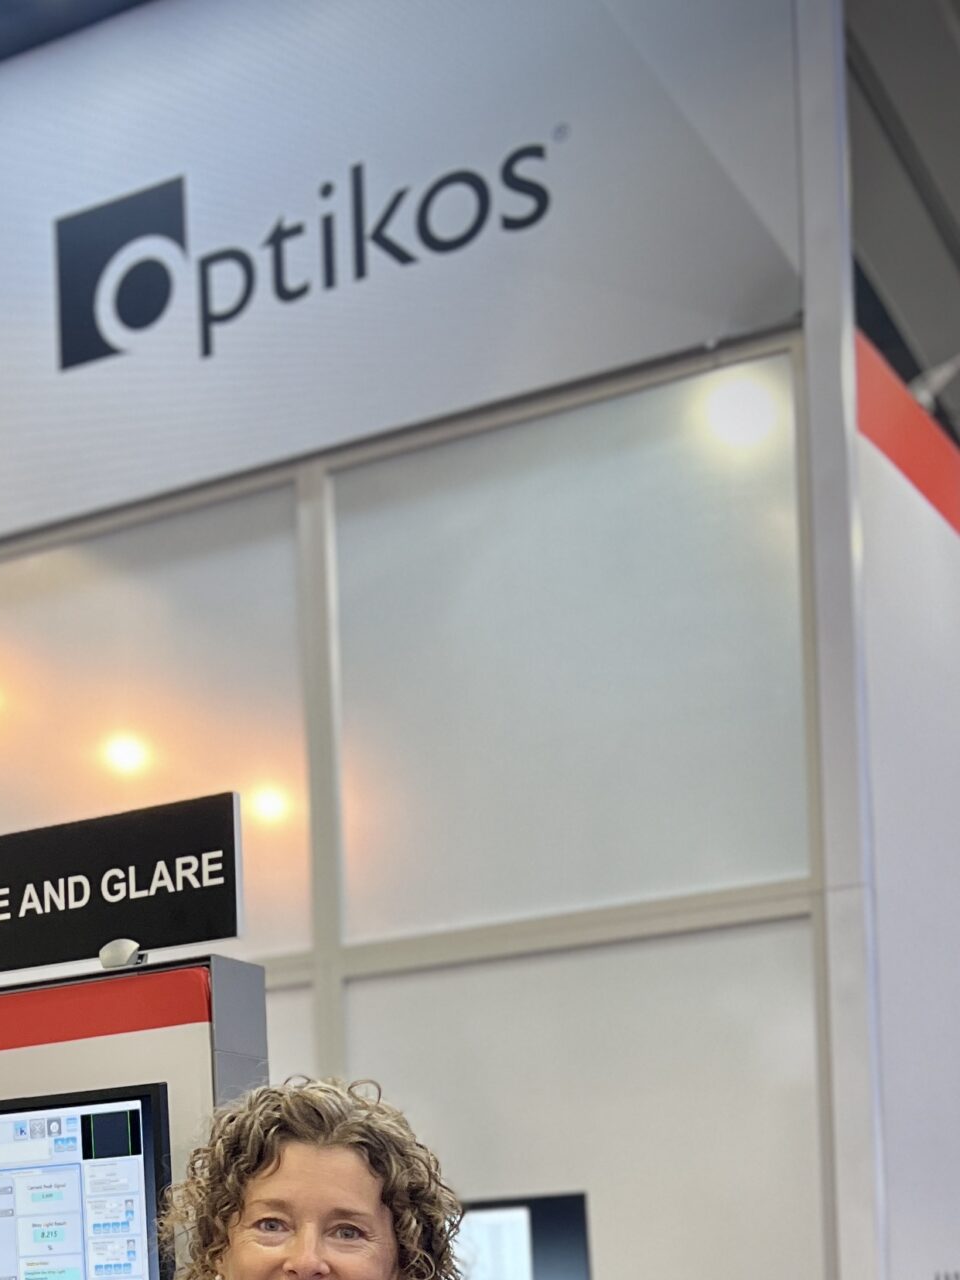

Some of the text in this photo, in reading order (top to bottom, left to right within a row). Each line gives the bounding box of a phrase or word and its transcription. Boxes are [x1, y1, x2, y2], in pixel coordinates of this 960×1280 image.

[93, 143, 551, 358] Optikos
[18, 874, 90, 918] AND
[100, 850, 225, 904] GLARE
